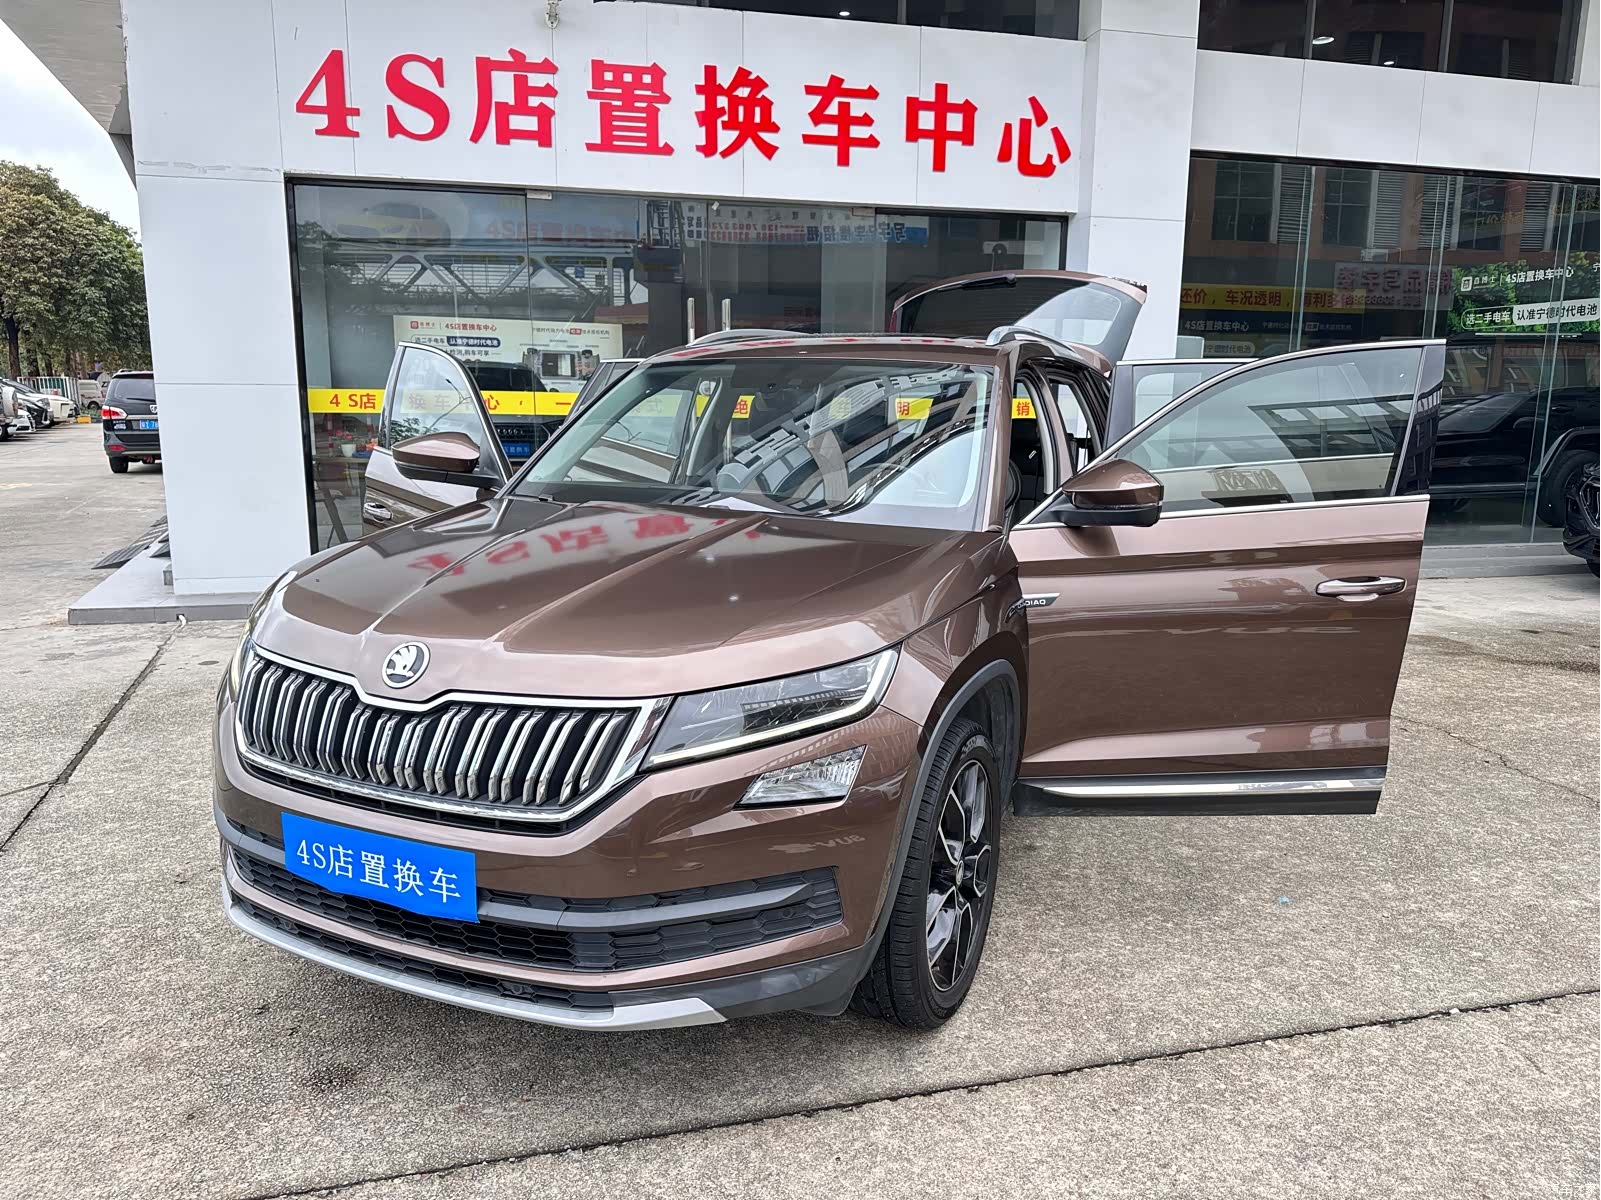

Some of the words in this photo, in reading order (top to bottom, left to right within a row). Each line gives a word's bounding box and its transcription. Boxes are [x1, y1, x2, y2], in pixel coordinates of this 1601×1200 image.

[295, 48, 1072, 178] 4S店置换车中心
[1505, 266, 1574, 283] 4S店置换车中心
[1465, 311, 1511, 325] 选二手电车
[1516, 304, 1598, 321] 认准宁德时代电池
[1016, 401, 1031, 416] 销
[296, 839, 461, 903] 4S店置换车
